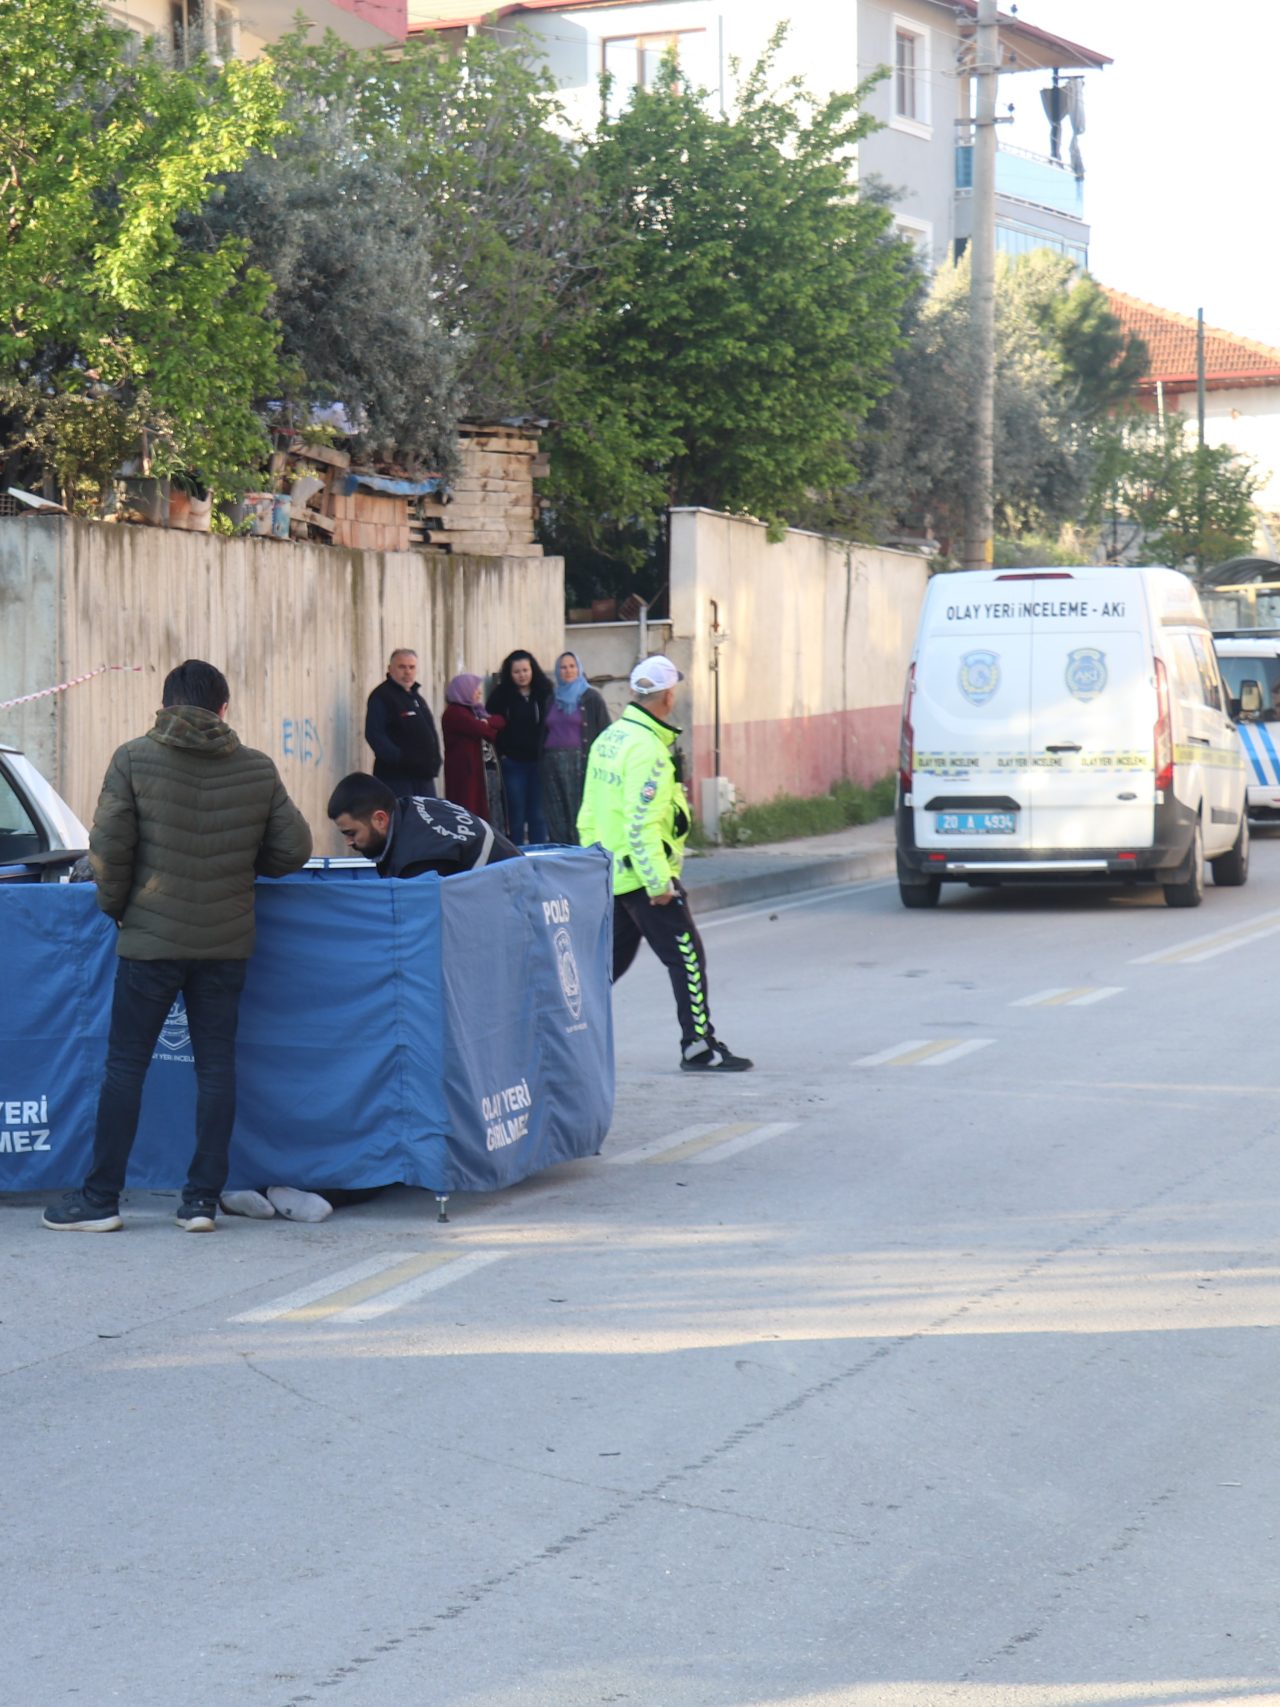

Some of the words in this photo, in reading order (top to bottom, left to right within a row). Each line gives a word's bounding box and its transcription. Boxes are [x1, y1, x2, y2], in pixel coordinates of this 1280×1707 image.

[946, 604, 981, 620] OLAY
[967, 815, 975, 829] A
[501, 1078, 532, 1113] YERİ
